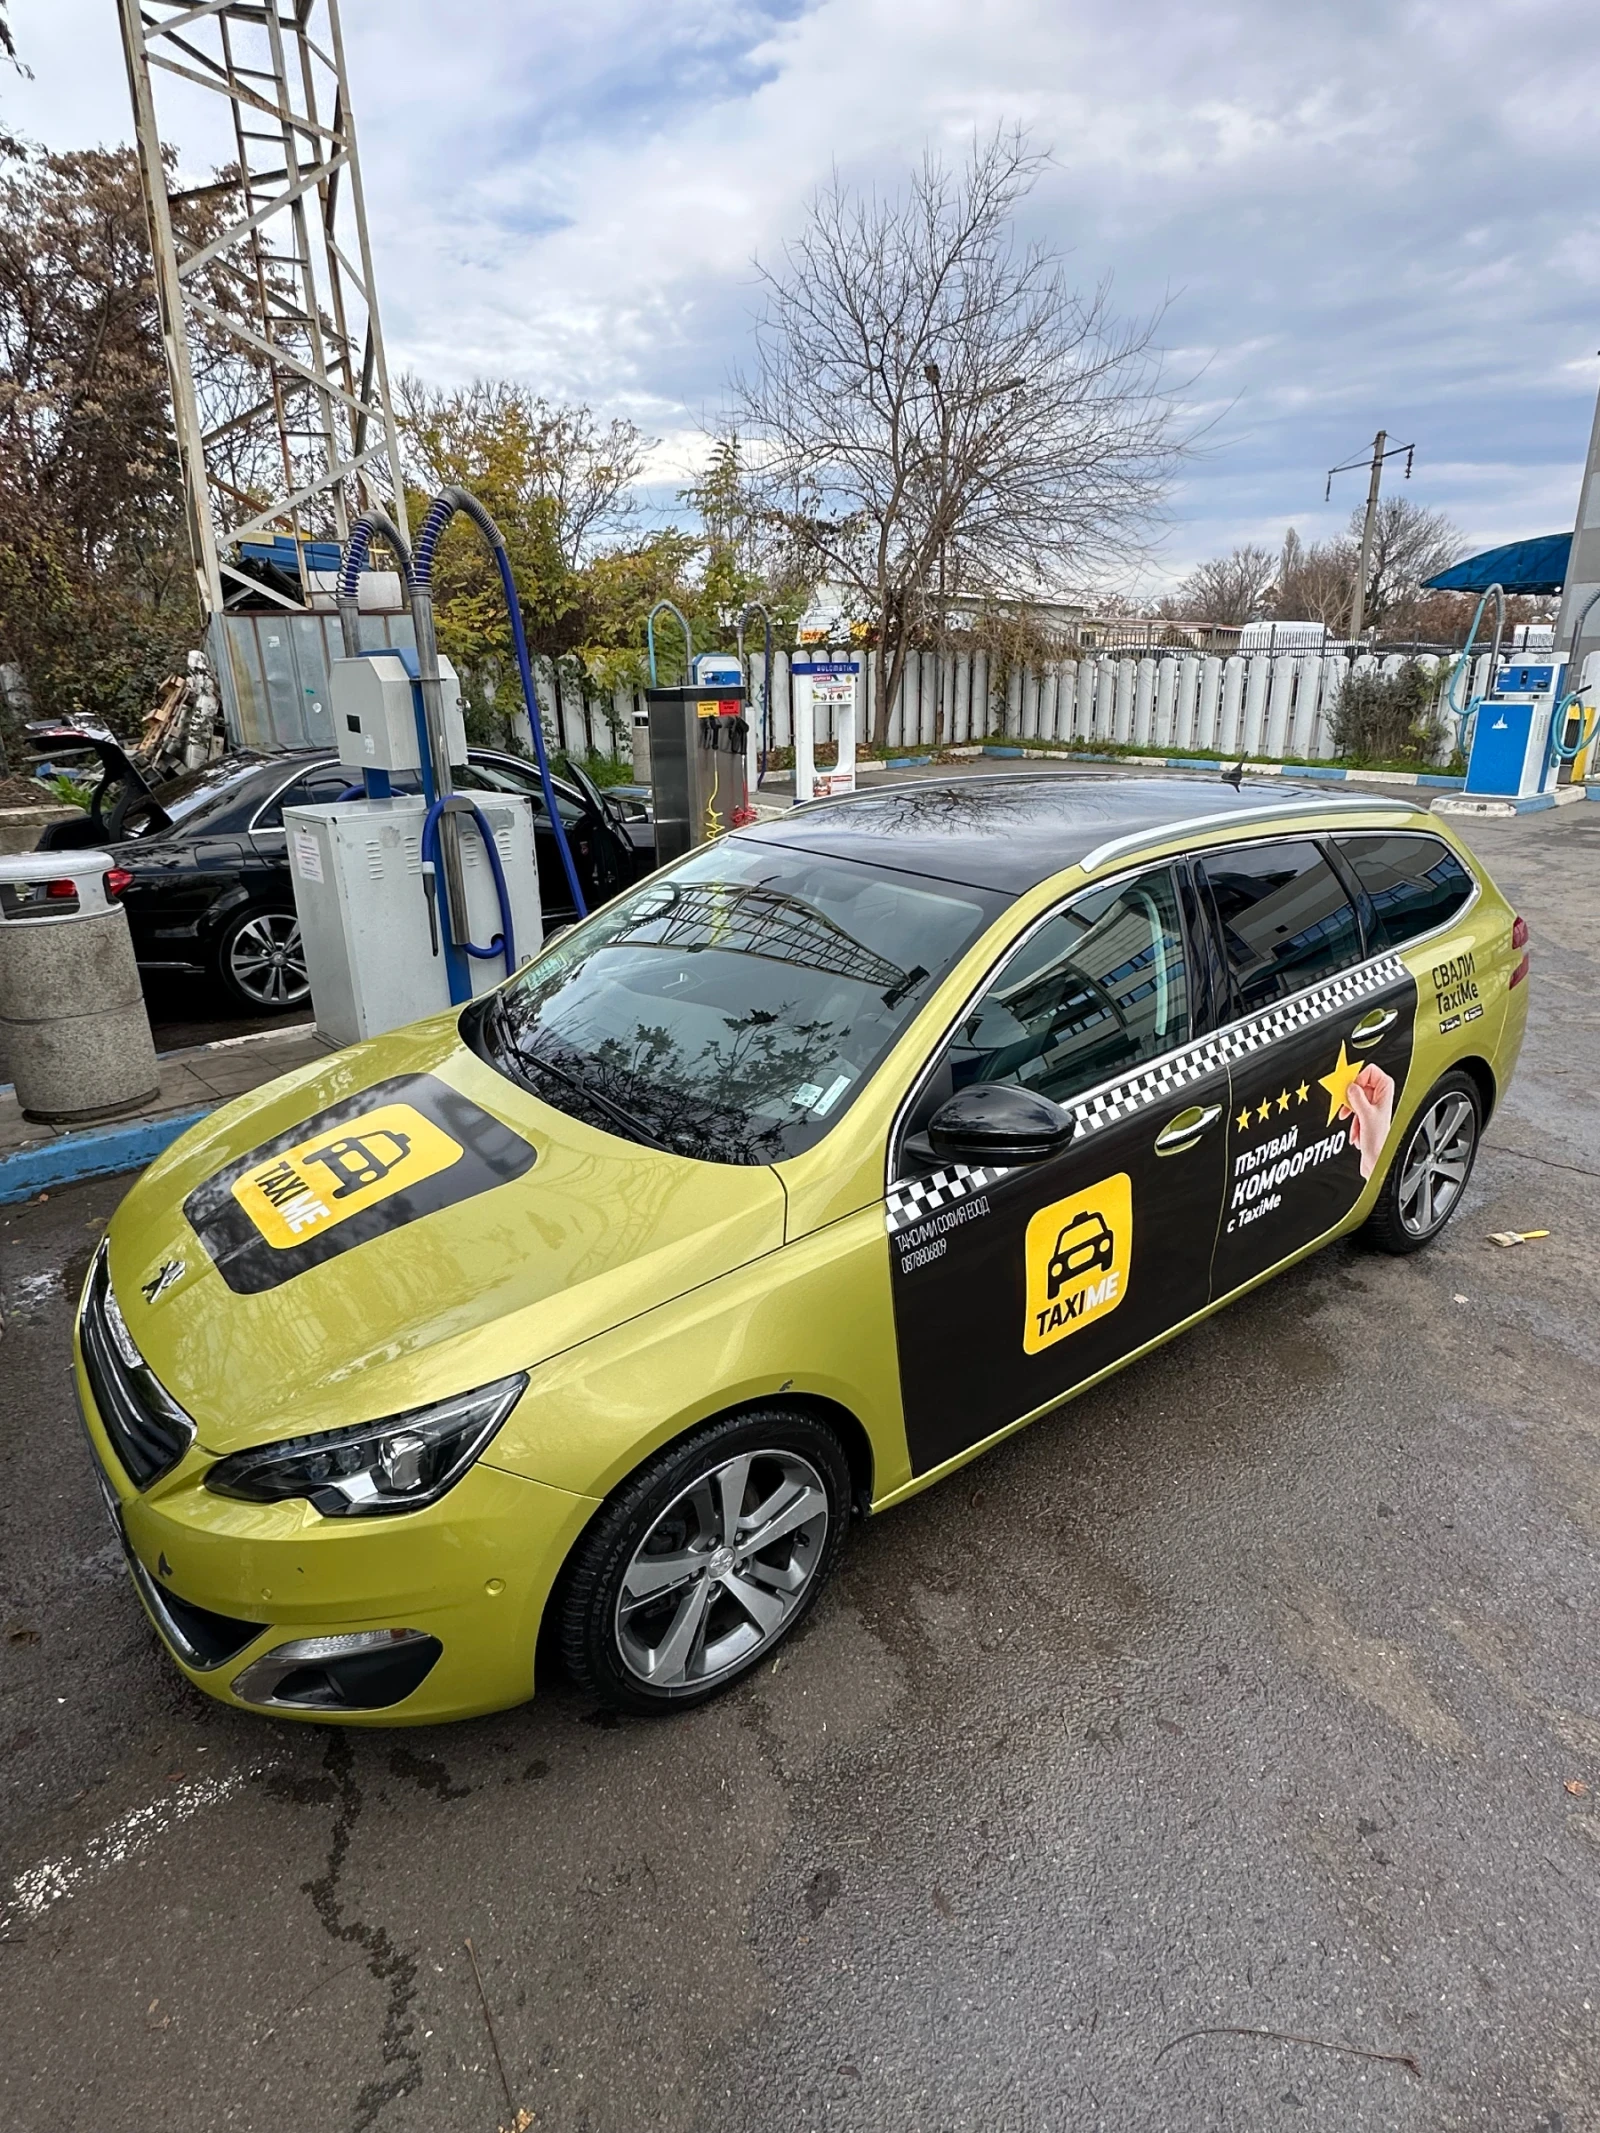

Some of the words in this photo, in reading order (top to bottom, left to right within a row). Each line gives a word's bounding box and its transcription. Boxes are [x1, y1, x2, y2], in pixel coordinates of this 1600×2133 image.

[1432, 952, 1476, 990] СВАЛИ
[1436, 980, 1479, 1015] TaxiMe
[1231, 1130, 1346, 1209] КОМФОРТНО
[1234, 1124, 1299, 1177] ПЪТУВАЙ
[254, 1160, 332, 1234] TAXIME
[895, 1219, 938, 1252] ТАКСИМИ
[936, 1206, 968, 1233] СОФИЯ
[965, 1195, 991, 1220] ЕООД
[1227, 1219, 1236, 1233] с
[1238, 1194, 1282, 1227] TaxiMe
[901, 1237, 947, 1274] 0878806809
[1036, 1271, 1120, 1337] TAXIME
